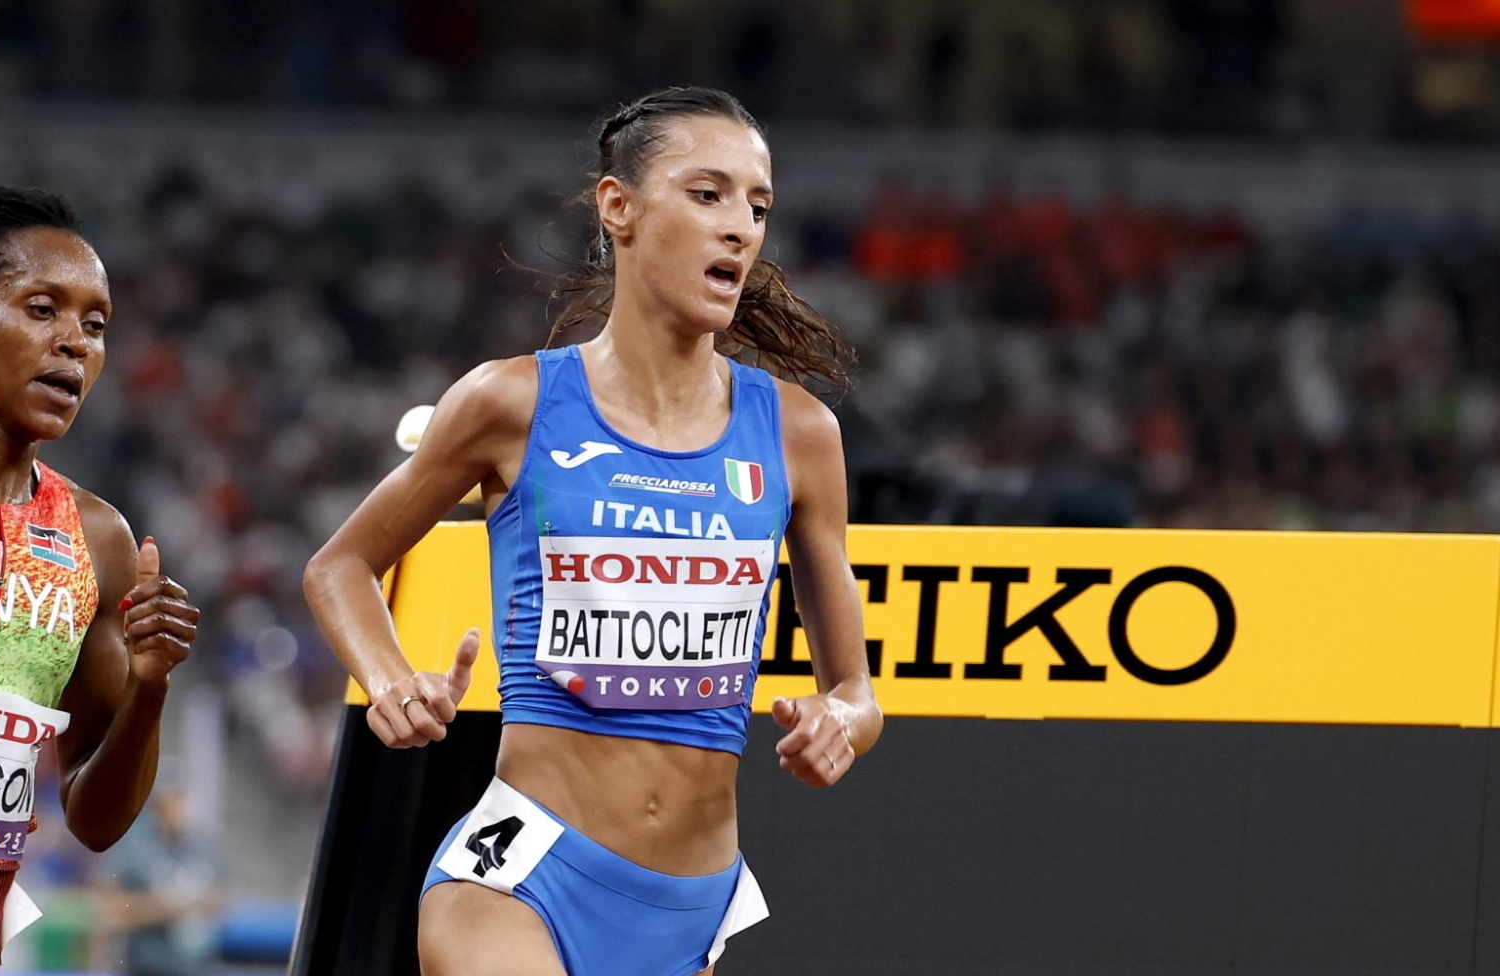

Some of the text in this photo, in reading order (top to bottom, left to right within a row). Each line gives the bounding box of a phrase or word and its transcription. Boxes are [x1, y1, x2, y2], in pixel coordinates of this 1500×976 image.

[612, 473, 716, 493] FRECCIAROSSA
[592, 500, 736, 541] ITALIA
[545, 553, 764, 586] HONDA
[548, 609, 753, 661] BATTOCLETTI
[758, 564, 1237, 687] EIKO
[464, 815, 526, 878] 4
